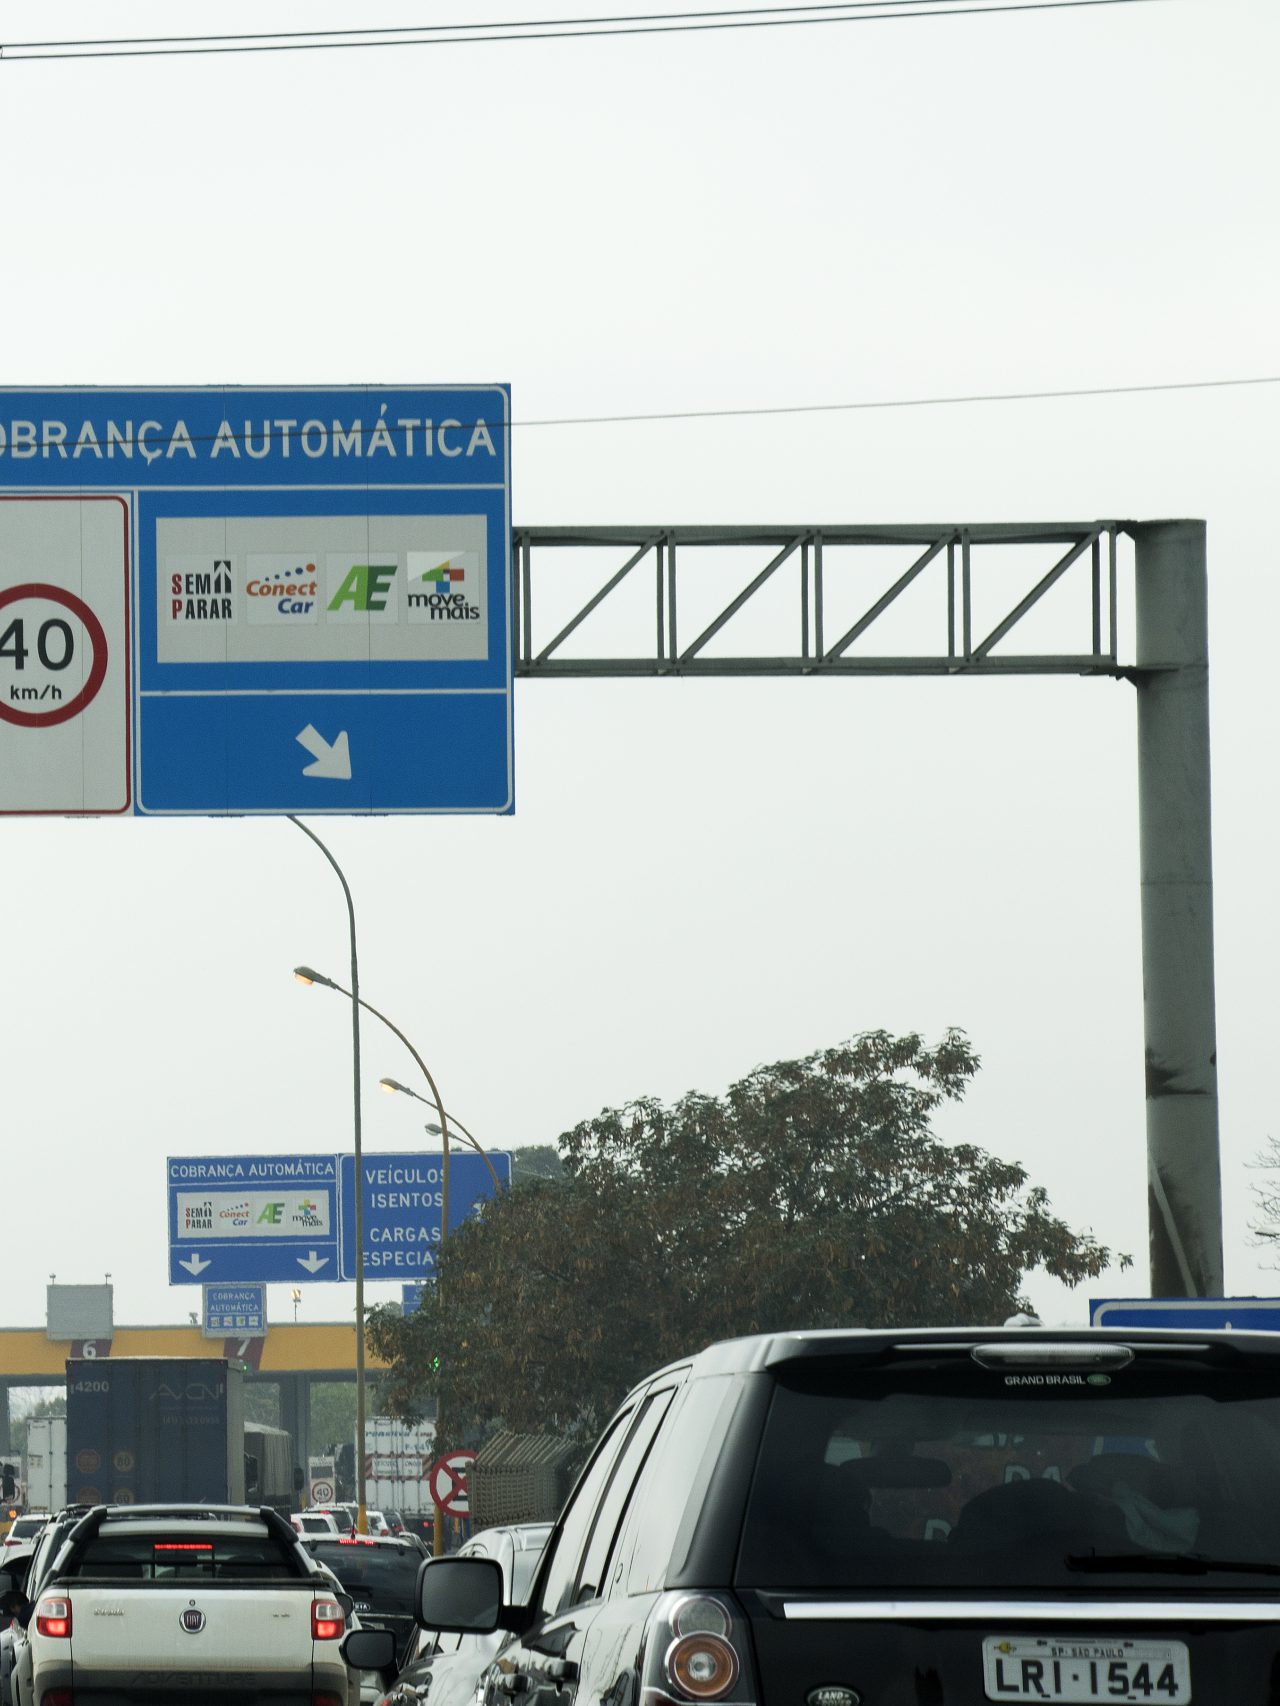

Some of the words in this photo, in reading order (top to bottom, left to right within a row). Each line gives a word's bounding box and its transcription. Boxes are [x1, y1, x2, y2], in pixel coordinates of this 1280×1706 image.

[210, 402, 497, 458] AUTOMÁTICA
[171, 573, 211, 595] SEM
[246, 580, 317, 597] Conect
[326, 565, 398, 611] AE
[278, 598, 314, 614] Car
[408, 593, 465, 607] move
[171, 598, 232, 620] PARAR
[430, 603, 480, 620] mais
[10, 684, 62, 700] km/h
[171, 1164, 245, 1179] COBRANÇA
[249, 1159, 334, 1177] AUTOMÁTICA
[372, 1192, 443, 1208] ISENTOS
[186, 1219, 213, 1229] PARAR
[233, 1218, 248, 1226] Car
[370, 1227, 441, 1242] CARGAS
[82, 1340, 97, 1358] 6
[237, 1337, 252, 1356] 7
[1004, 1375, 1044, 1385] GRAND
[1046, 1374, 1087, 1385] BRASIL
[186, 1614, 200, 1626] FIAT
[1094, 1648, 1124, 1658] PAULO
